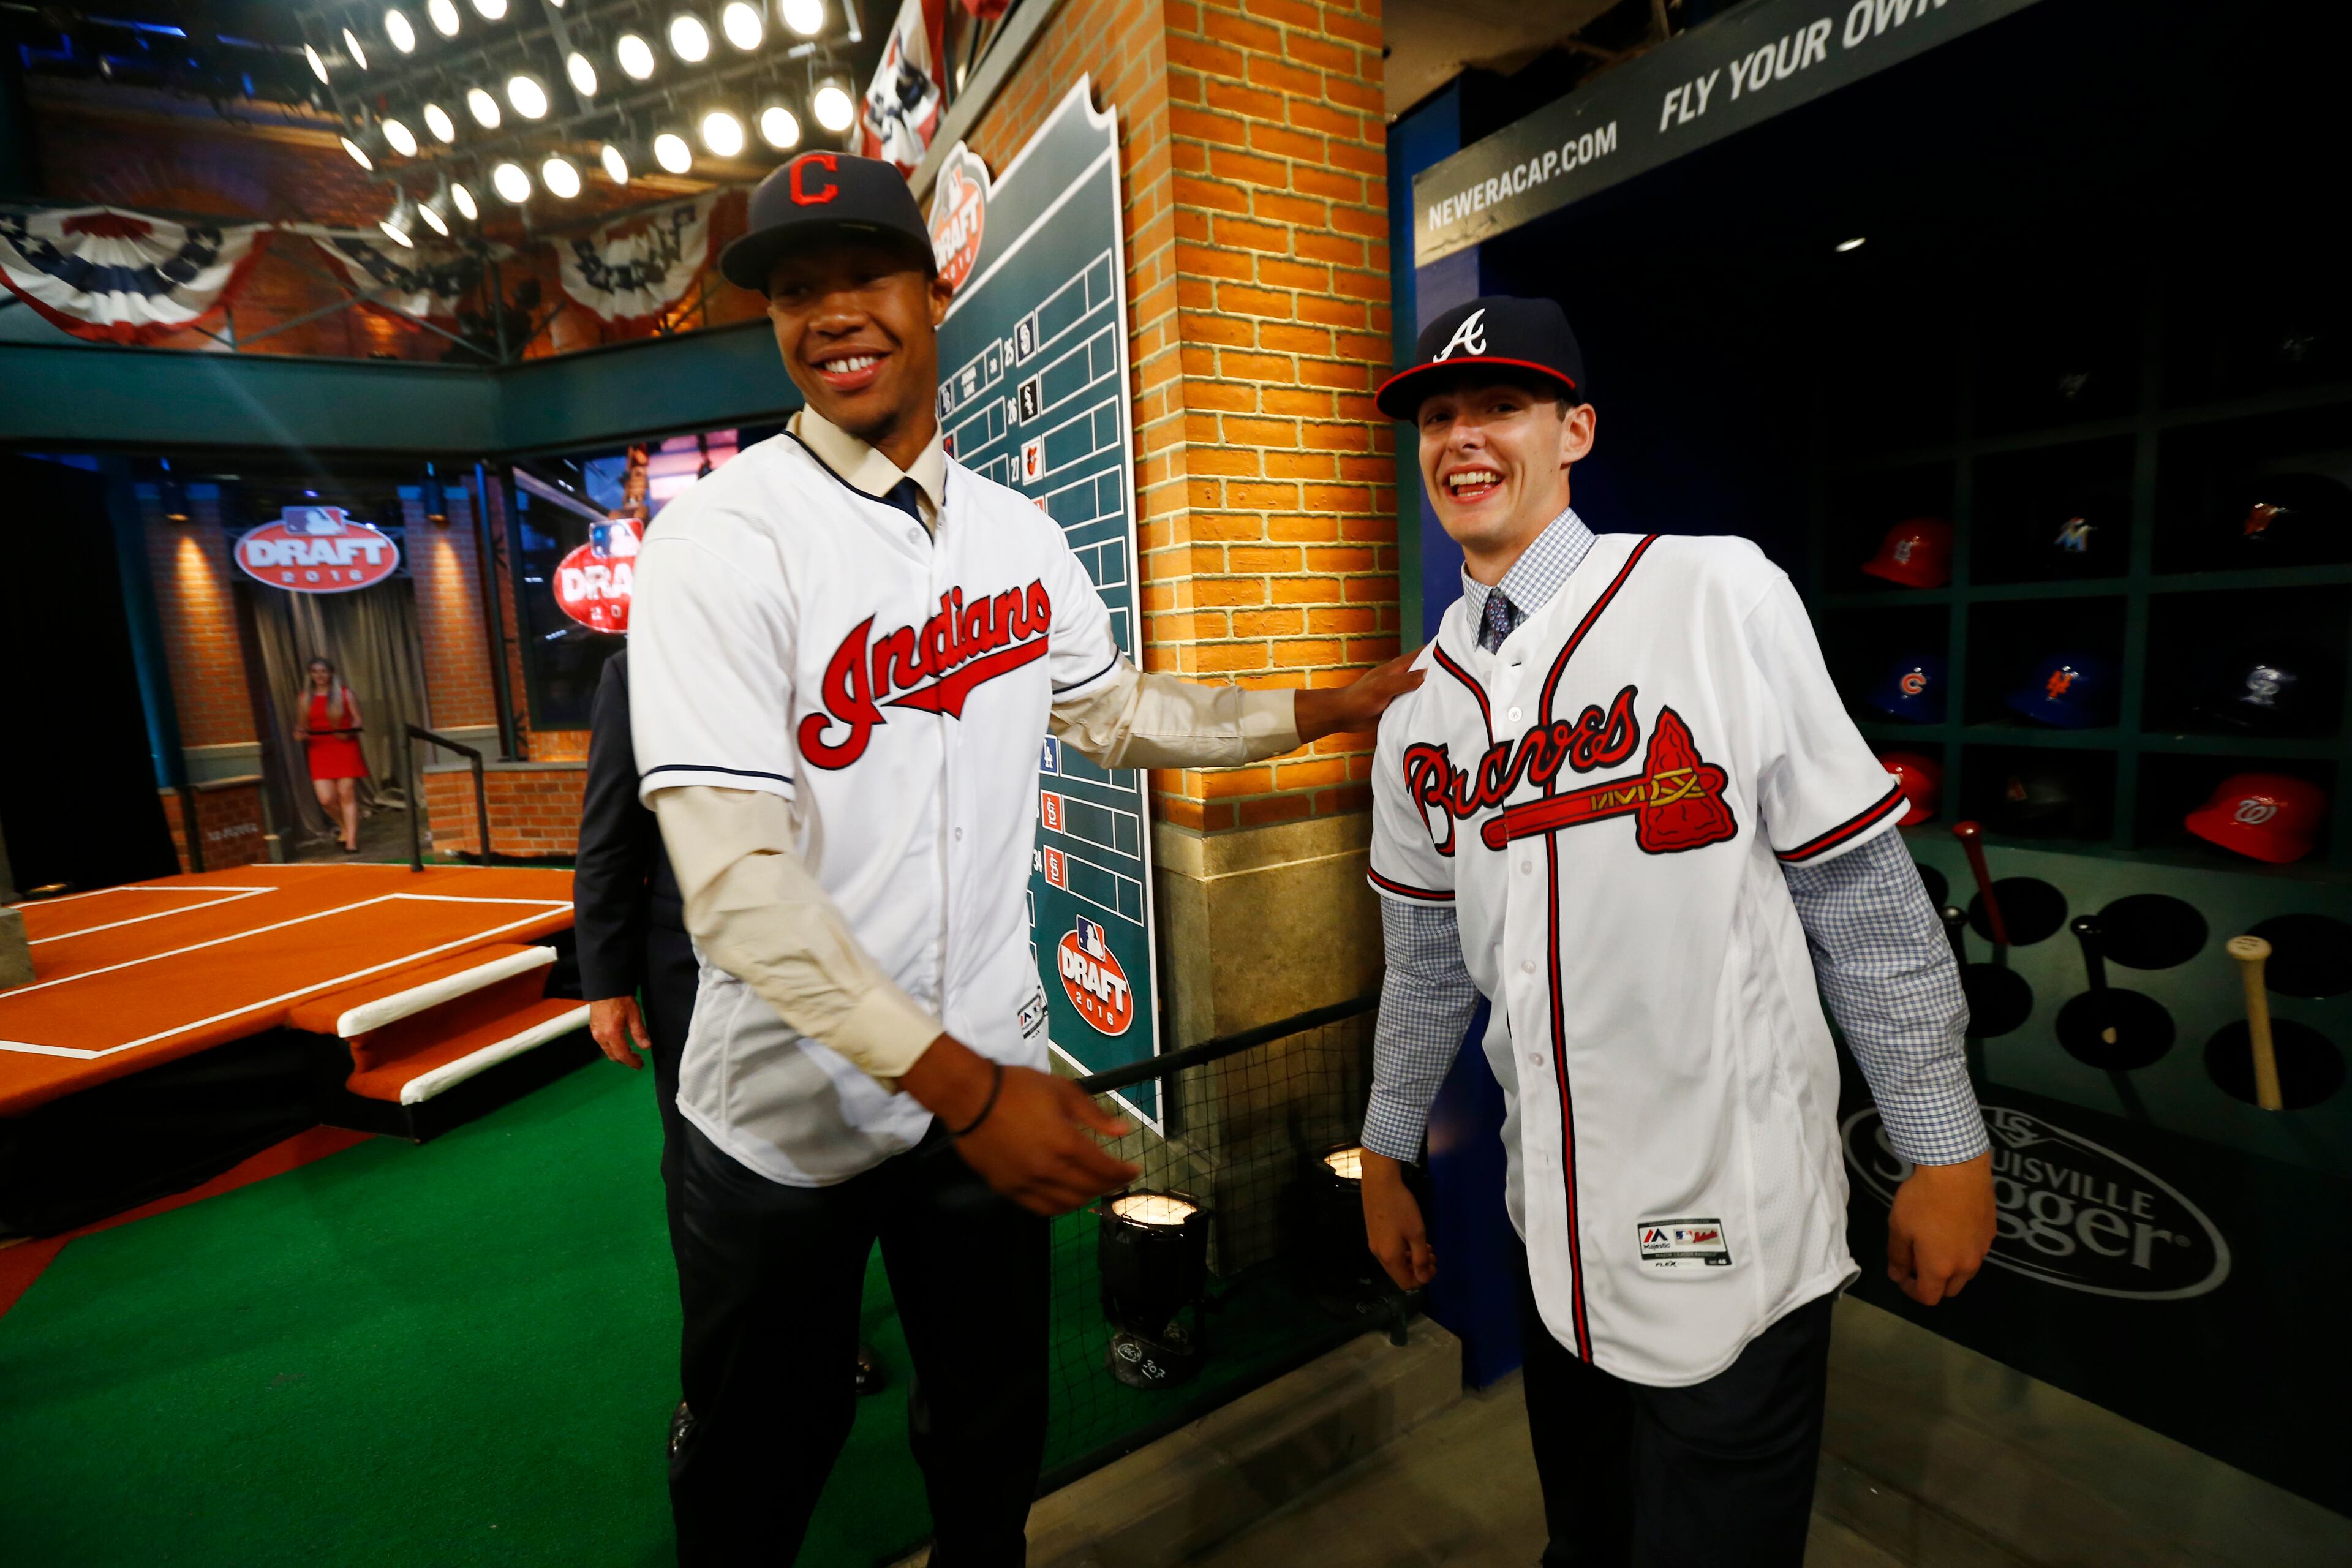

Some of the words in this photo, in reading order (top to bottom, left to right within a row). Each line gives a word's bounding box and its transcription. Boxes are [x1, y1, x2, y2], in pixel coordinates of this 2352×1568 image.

[1659, 69, 1720, 133] FLY
[1729, 17, 1832, 100] YOUR
[790, 154, 839, 206] C
[1428, 121, 1617, 231] NEWERACAP.COM
[1432, 308, 1487, 363] A
[1011, 456, 1019, 482] 27
[246, 538, 387, 567] DRAFT
[798, 578, 1052, 771] Indians
[1403, 685, 1640, 858] Braves
[1061, 944, 1127, 1012] DRAFT
[1076, 991, 1114, 1026] 2016
[1873, 1123, 2173, 1270] Sgger
[1989, 1145, 2155, 1220] UISVILLE
